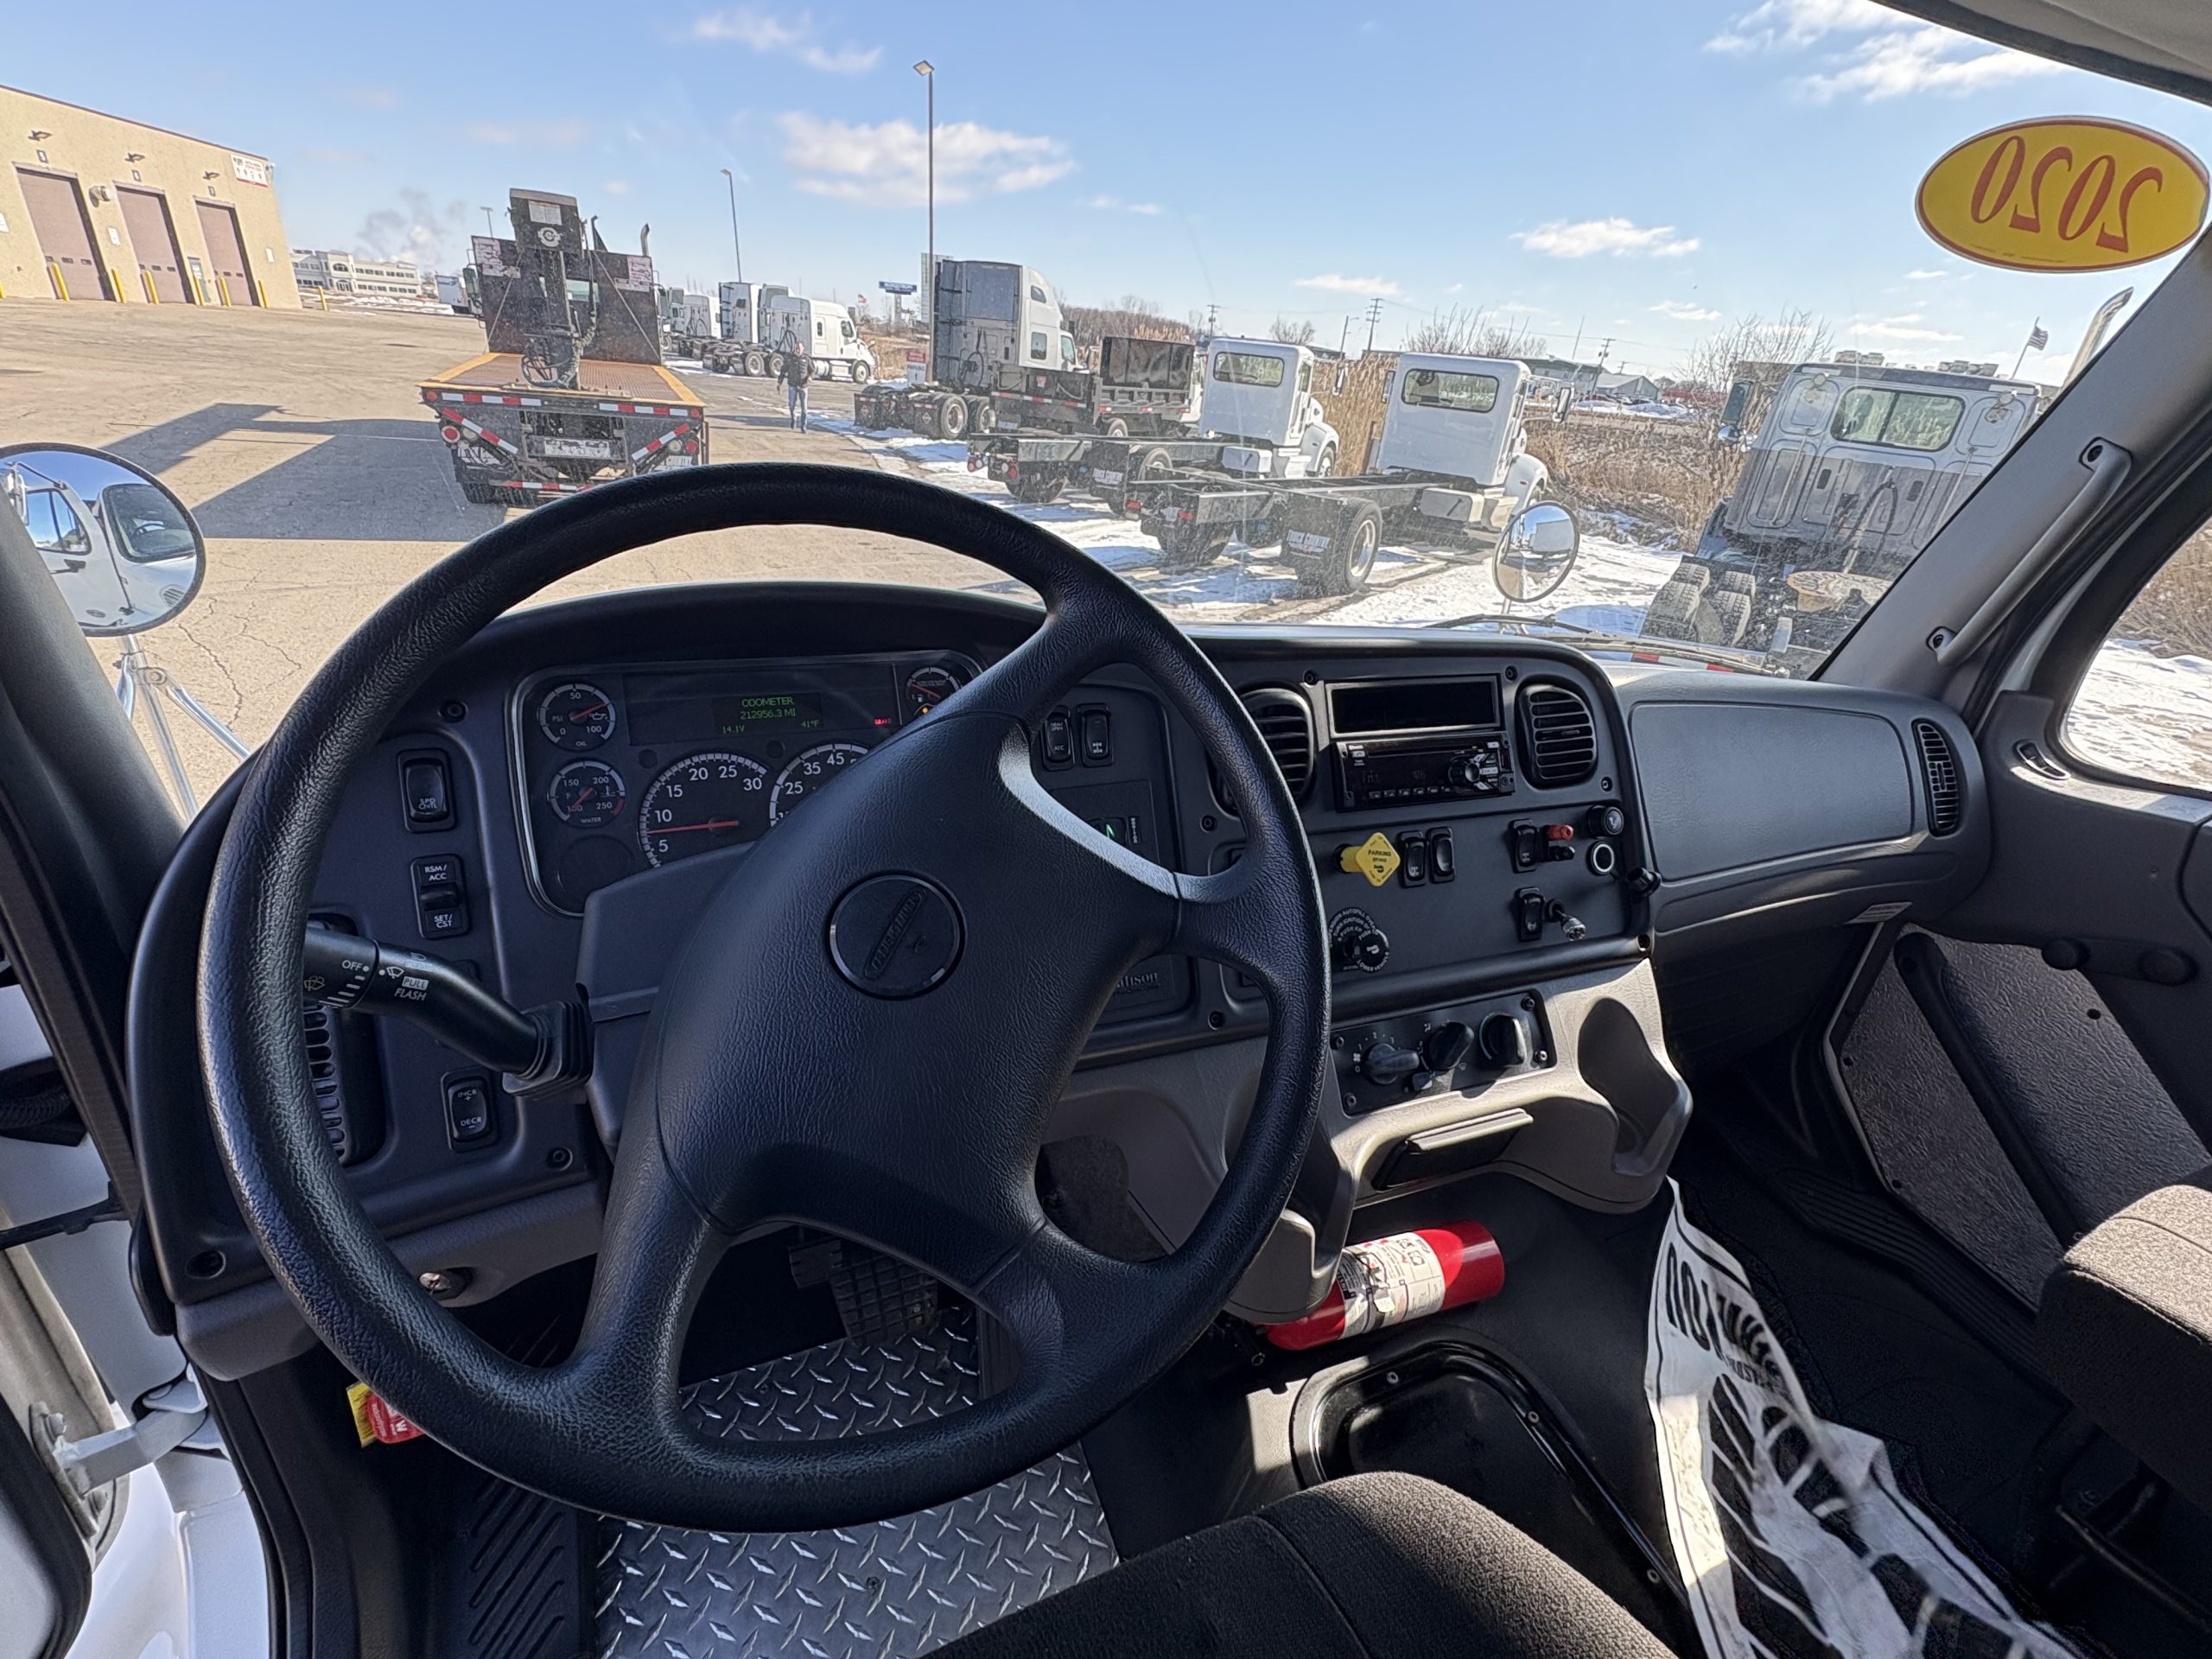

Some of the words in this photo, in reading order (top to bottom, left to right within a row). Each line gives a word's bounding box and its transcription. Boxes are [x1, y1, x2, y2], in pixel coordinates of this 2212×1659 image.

[741, 696, 795, 708] ODOMETER
[740, 709, 783, 720] 212956.3
[785, 708, 797, 717] MI
[585, 725, 602, 734] 100
[826, 752, 845, 766] 45
[689, 766, 709, 781] 20
[718, 765, 738, 779] 25
[803, 762, 822, 776] 35
[563, 779, 580, 787] 150
[593, 776, 610, 785] 200
[743, 778, 763, 791] 30
[666, 784, 684, 798] 15
[785, 780, 804, 796] 25
[595, 802, 613, 810] 250
[654, 809, 673, 823] 10
[658, 839, 669, 853] 5
[429, 873, 448, 881] ACC
[436, 920, 452, 929] CST
[341, 959, 363, 972] OFF
[404, 978, 427, 989] PULL
[394, 988, 427, 1001] FLASH
[460, 1116, 483, 1127] DECR
